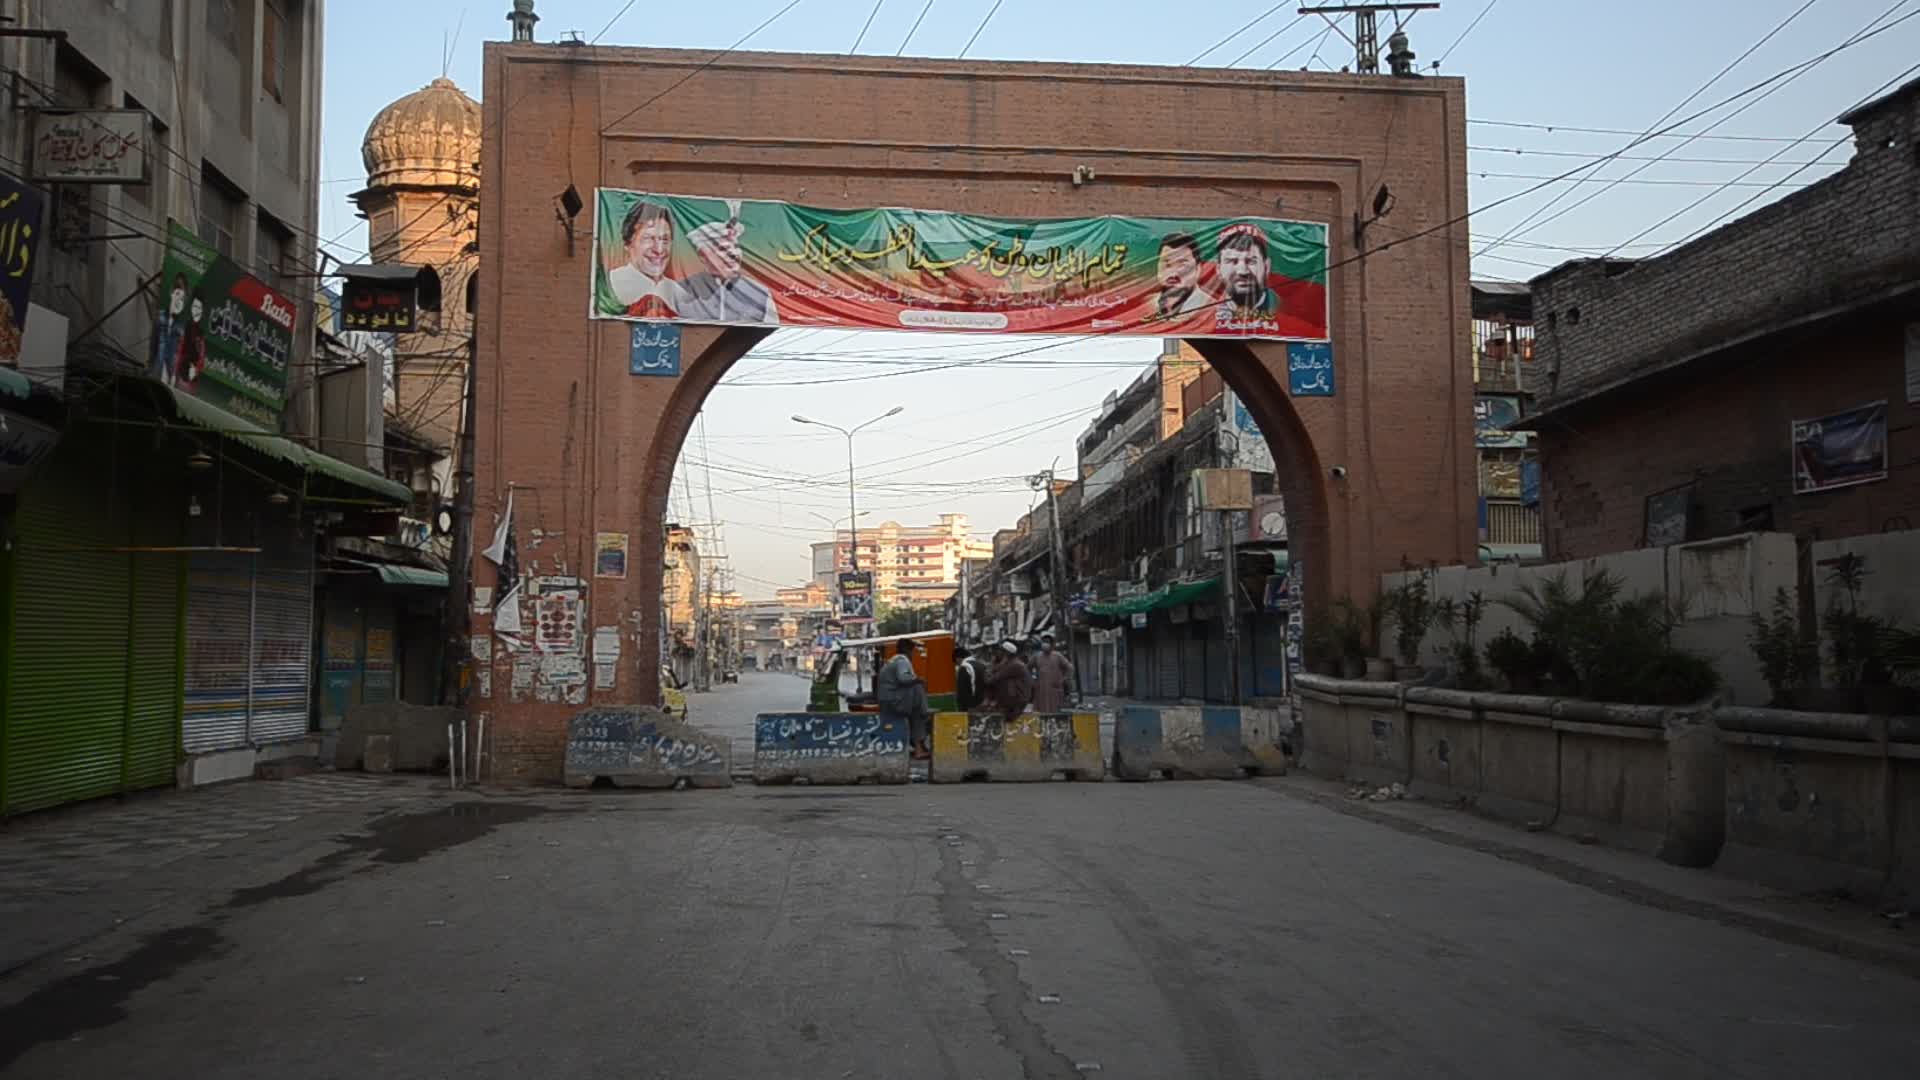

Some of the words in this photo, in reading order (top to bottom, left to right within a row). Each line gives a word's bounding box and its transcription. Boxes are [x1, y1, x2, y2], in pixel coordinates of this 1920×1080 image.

[778, 224, 853, 272] مبارک
[852, 223, 916, 270] الفطر
[913, 248, 978, 277] عید
[976, 240, 999, 271] کو
[990, 234, 1028, 278] وطن
[1083, 243, 1128, 288] تمام
[260, 293, 294, 328] Bata
